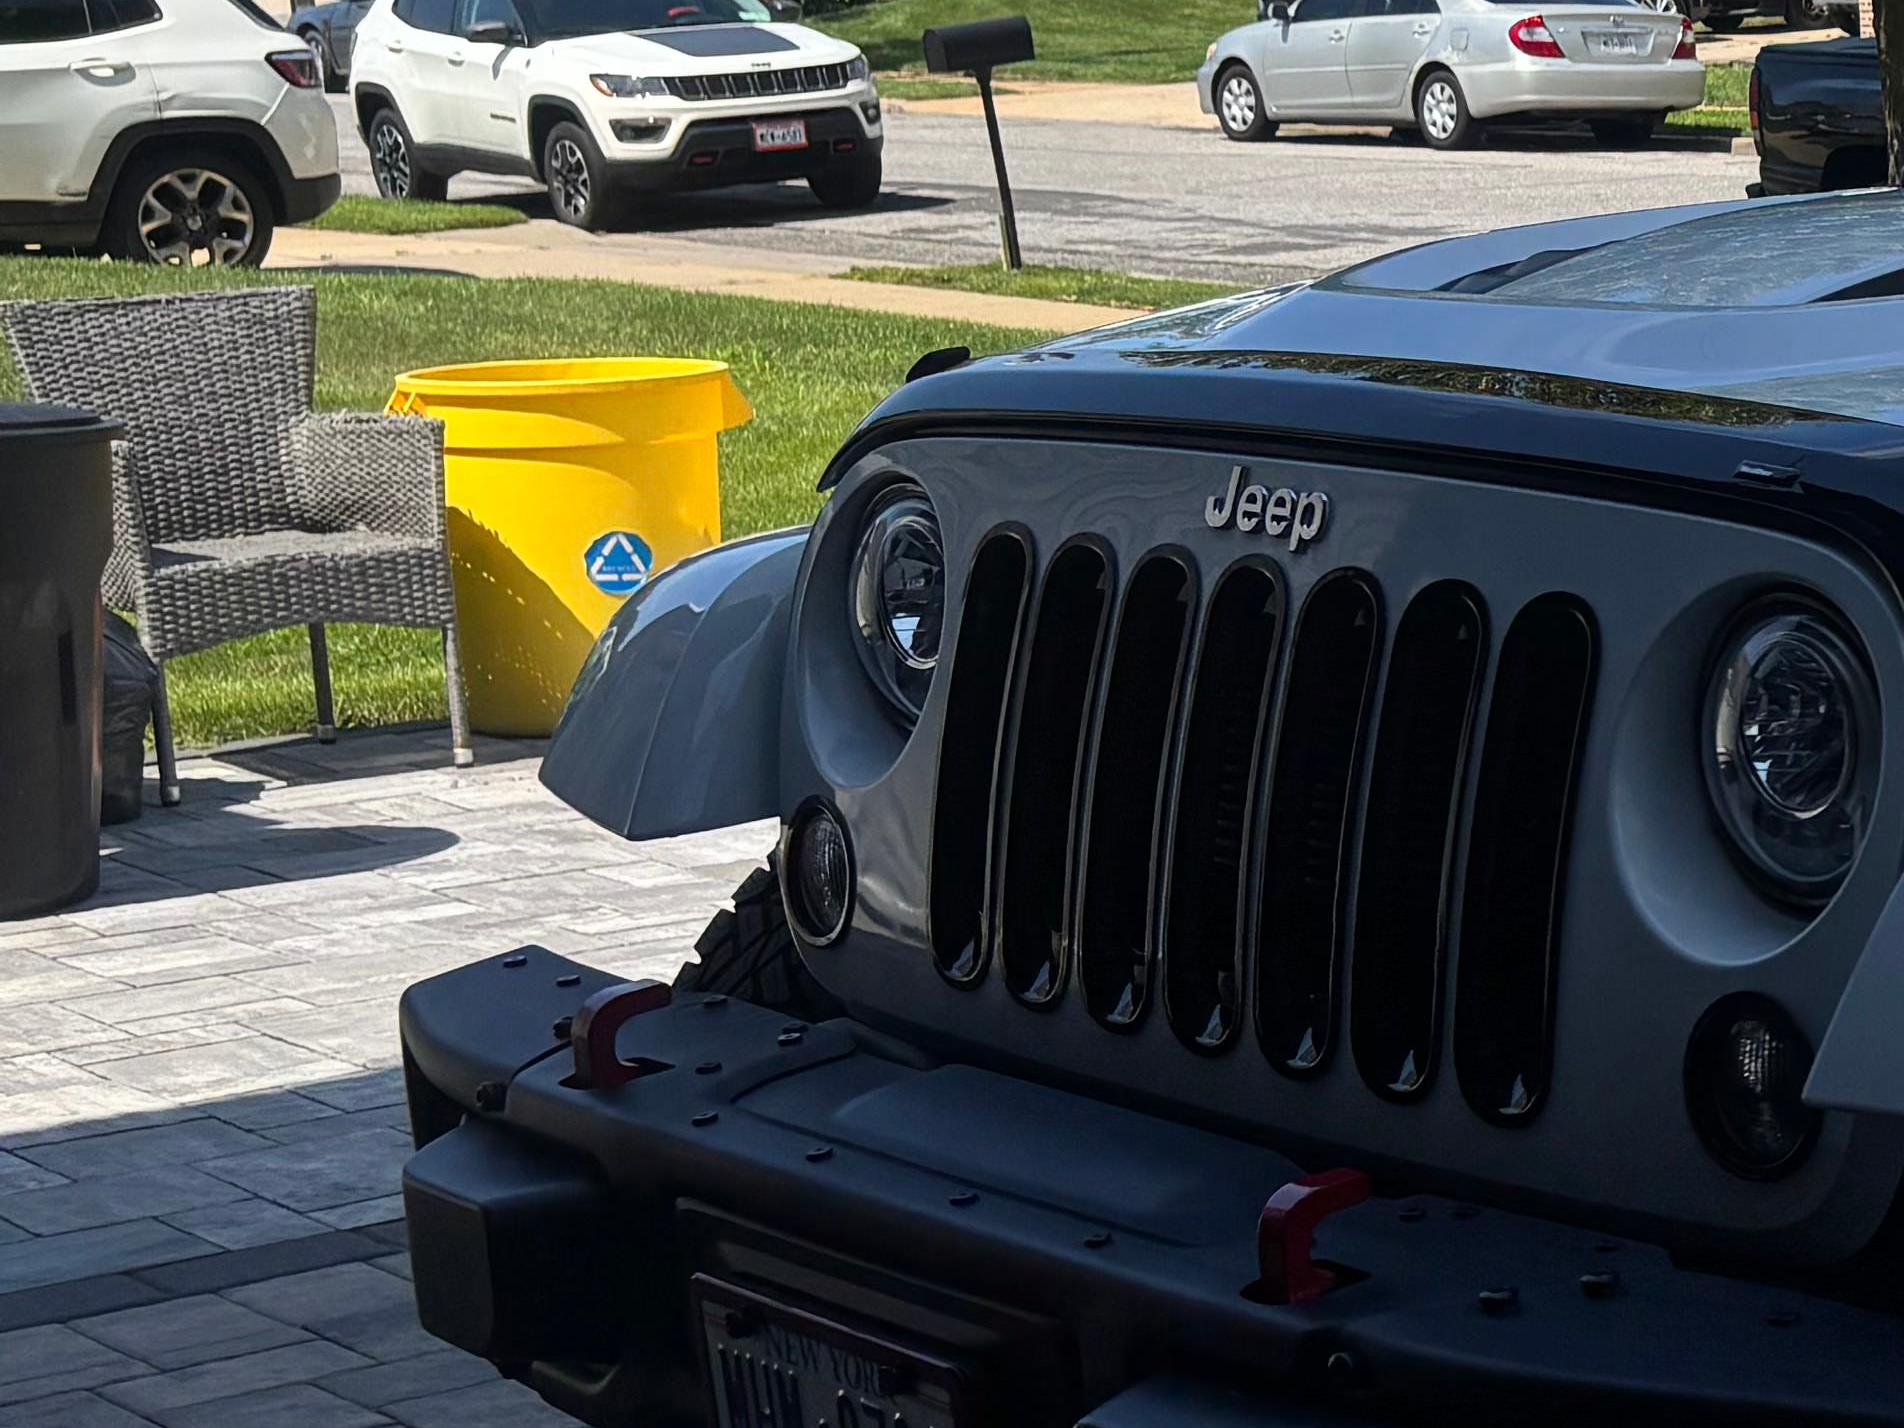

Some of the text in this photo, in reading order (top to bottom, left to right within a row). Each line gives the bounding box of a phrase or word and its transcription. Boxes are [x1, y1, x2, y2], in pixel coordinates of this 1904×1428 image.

[1204, 465, 1330, 552] Jeep
[767, 1324, 896, 1400] NEW YOR
